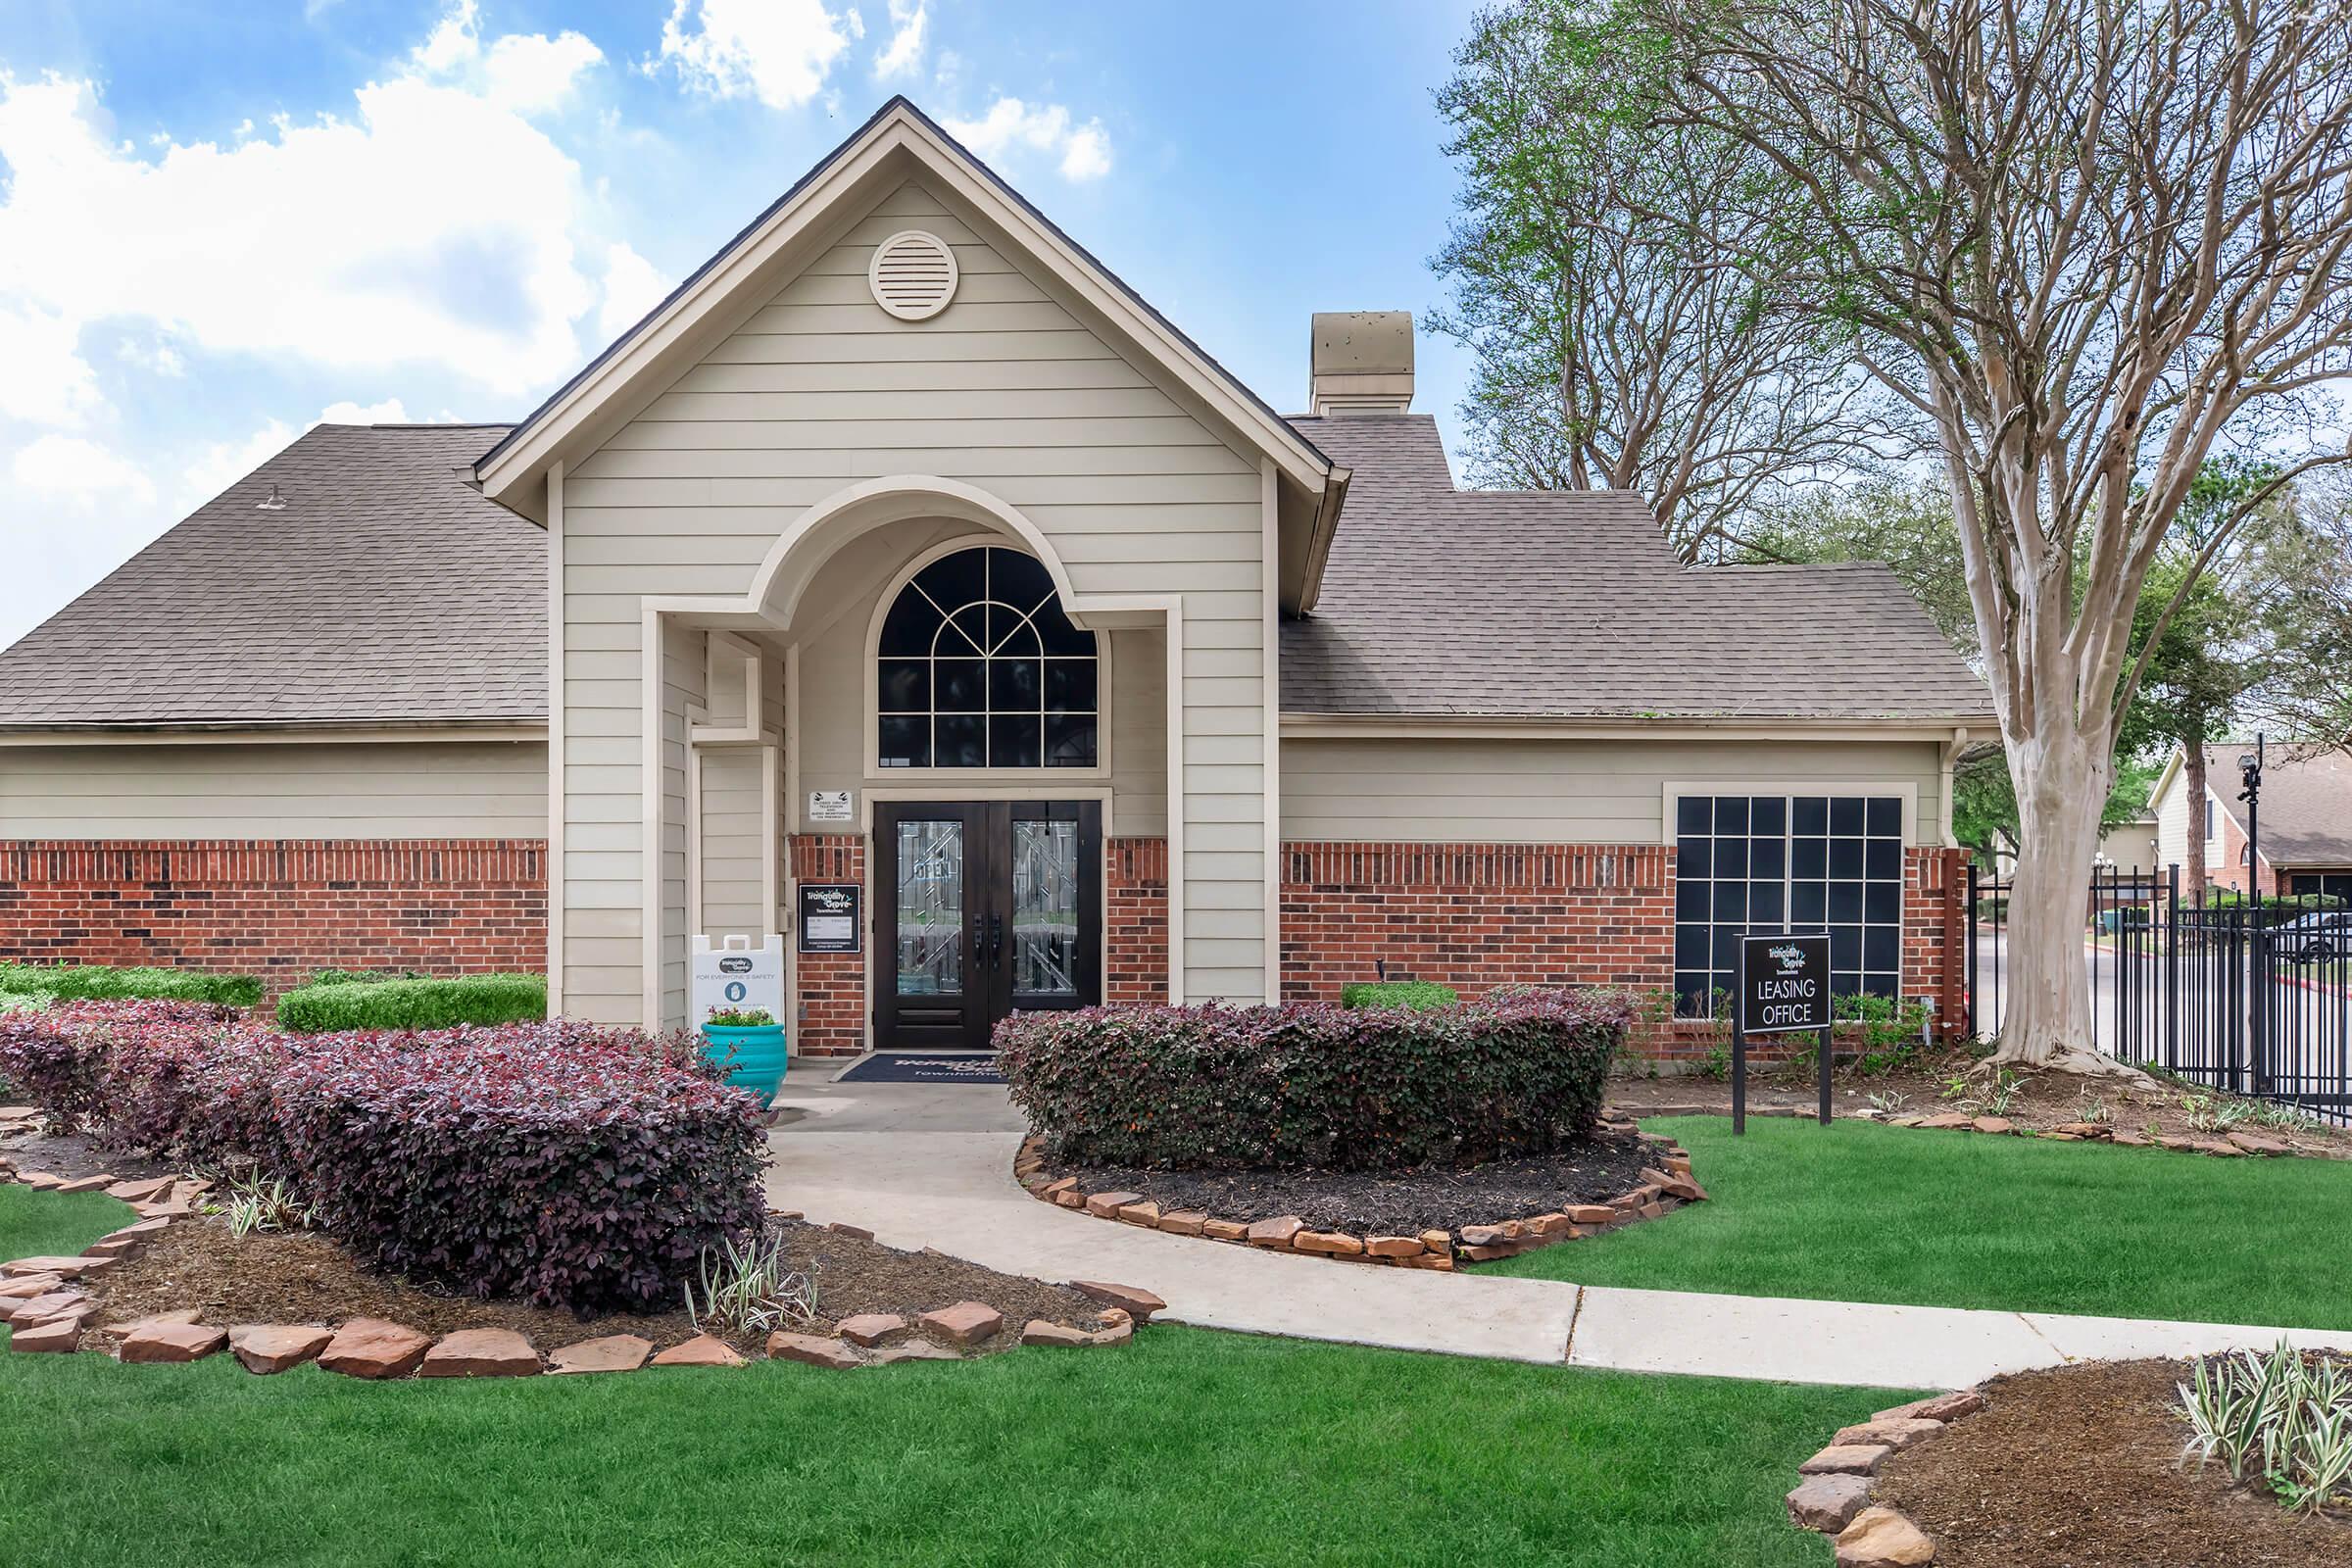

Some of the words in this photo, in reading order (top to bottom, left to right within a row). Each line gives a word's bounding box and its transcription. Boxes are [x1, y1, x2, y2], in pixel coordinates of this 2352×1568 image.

[807, 890, 846, 903] Tranquility
[825, 900, 849, 908] Grove
[1769, 946, 1800, 960] Tranquility
[1784, 957, 1804, 969] Grove
[1758, 978, 1816, 1000] LEASING
[1762, 1003, 1812, 1025] OFFICE
